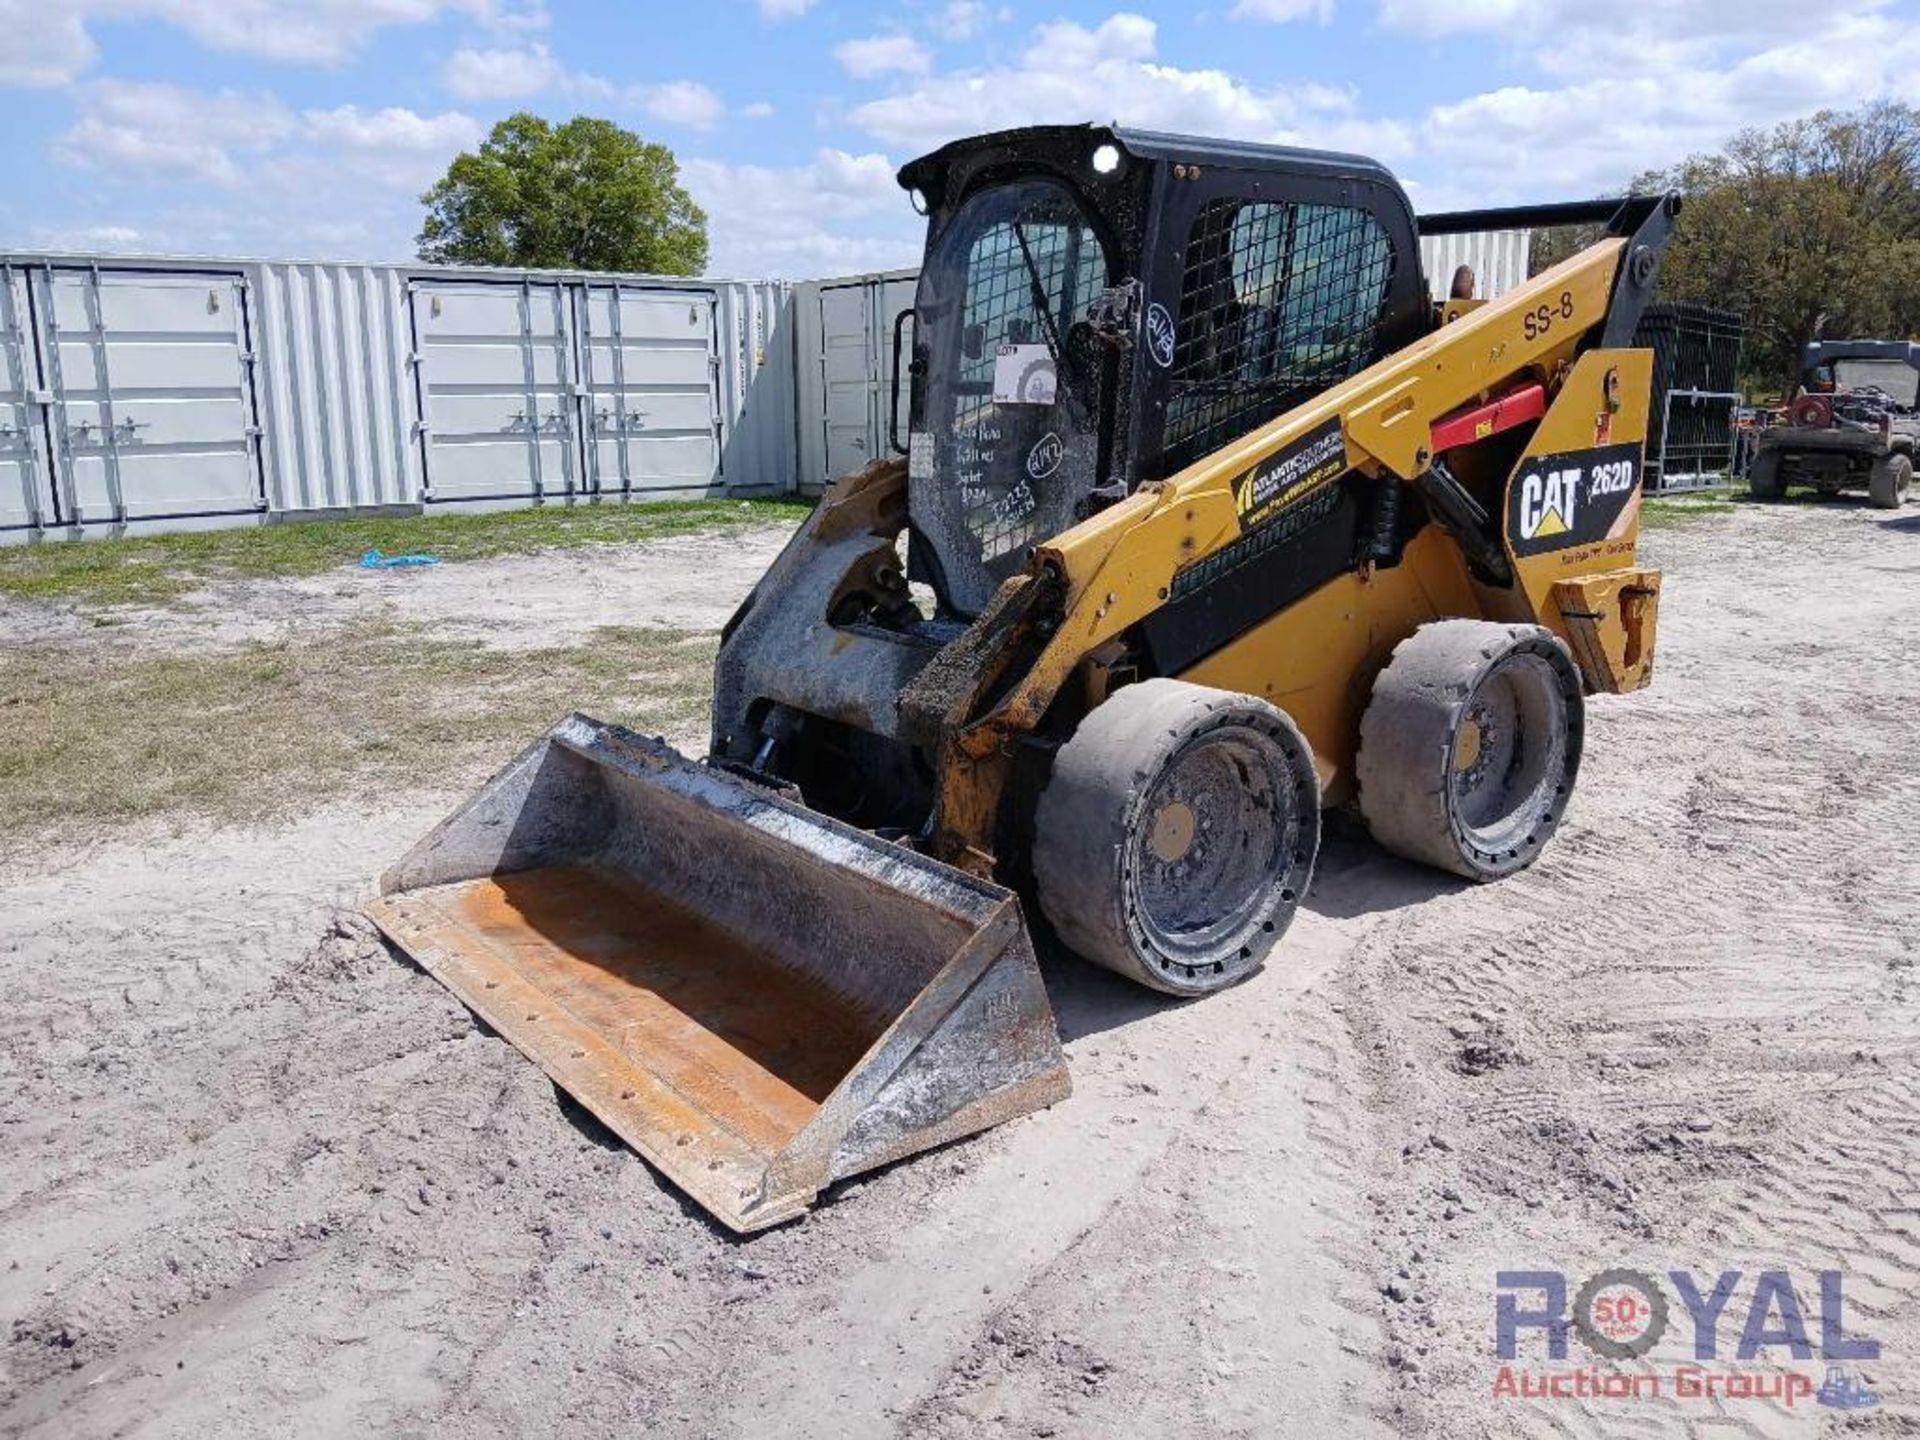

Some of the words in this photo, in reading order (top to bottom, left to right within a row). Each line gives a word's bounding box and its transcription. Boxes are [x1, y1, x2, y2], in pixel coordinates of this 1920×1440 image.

[1524, 291, 1573, 341] SS-8
[1521, 468, 1581, 539] CAT
[1592, 461, 1632, 495] 262D
